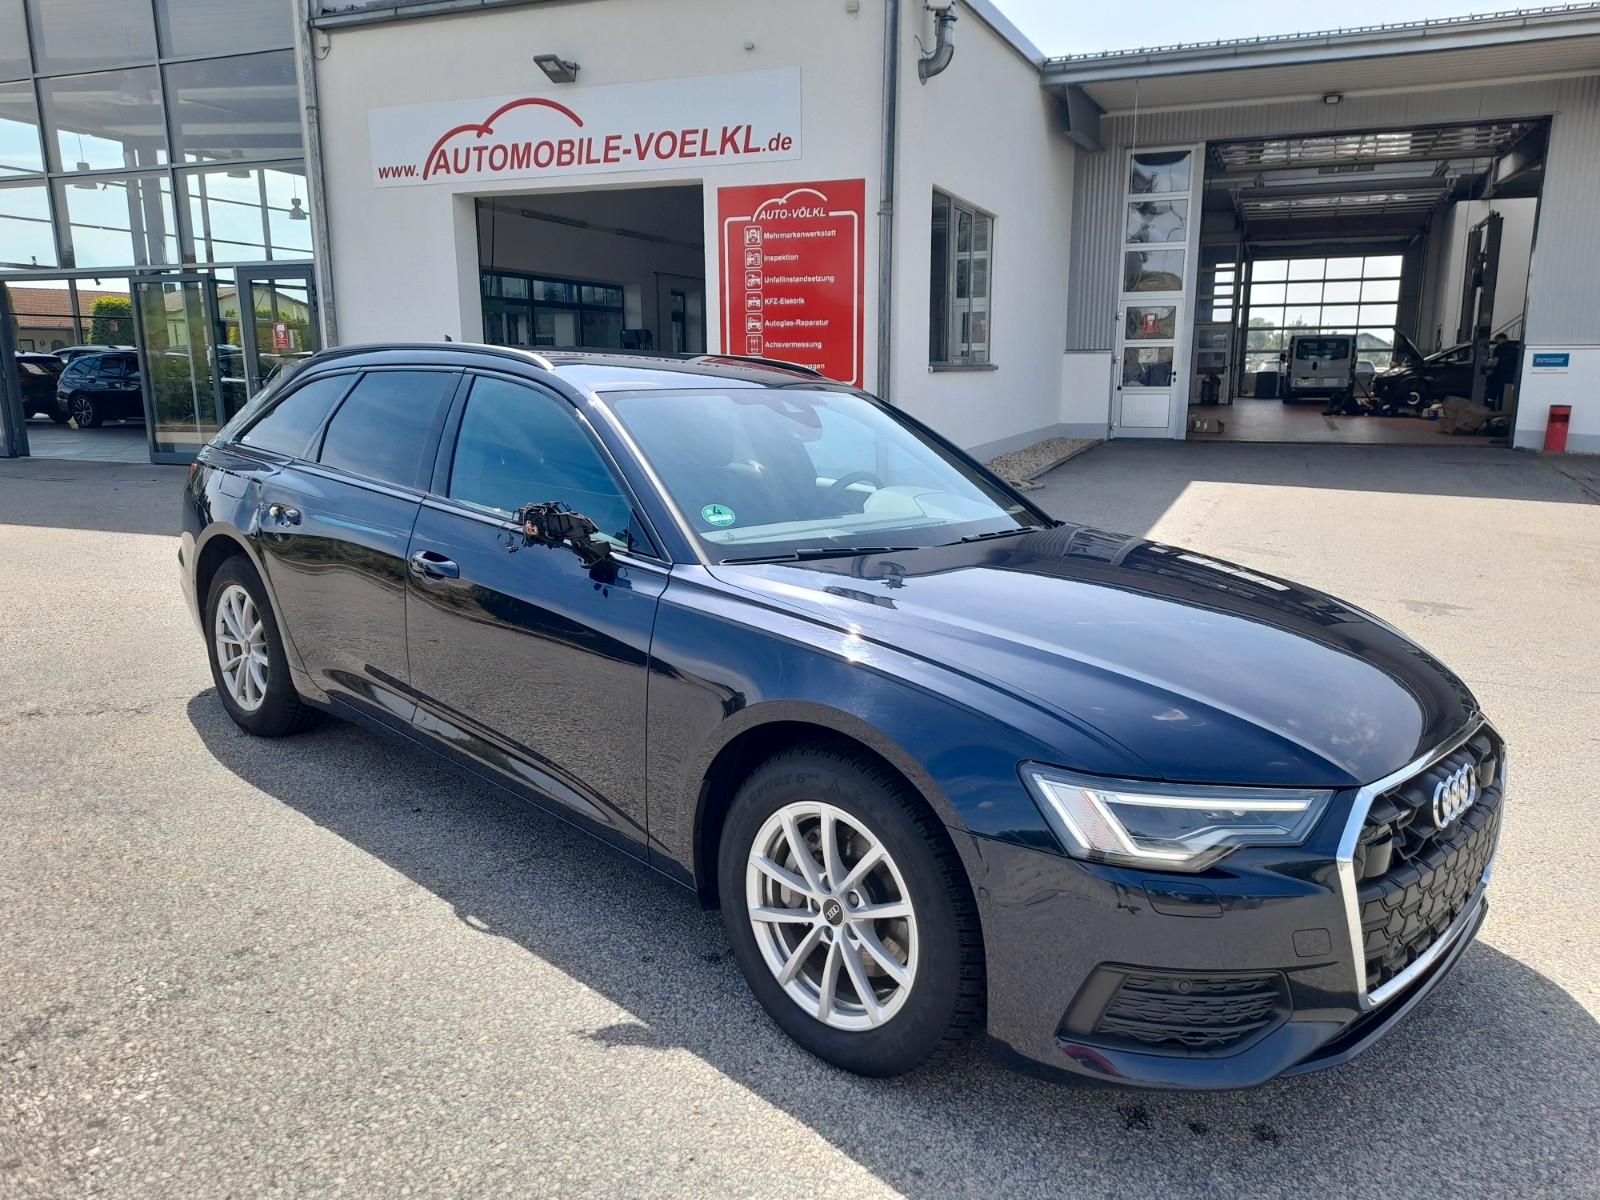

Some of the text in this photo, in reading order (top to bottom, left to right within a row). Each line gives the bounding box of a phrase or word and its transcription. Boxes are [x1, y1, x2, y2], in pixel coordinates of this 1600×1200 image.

[378, 124, 792, 179] www.AUTOMOBILE-VOELKL.de
[759, 206, 826, 220] AUTO-VÖLKL
[763, 230, 836, 239] Mehrmarkenwerkstatt
[763, 254, 799, 262] Inspektion
[764, 275, 835, 284] Unfallinstandsetzung
[764, 297, 805, 305] KFZ-Elektrik
[764, 319, 829, 328] Autoglas-Reparatur
[765, 341, 822, 349] Achsvermessung
